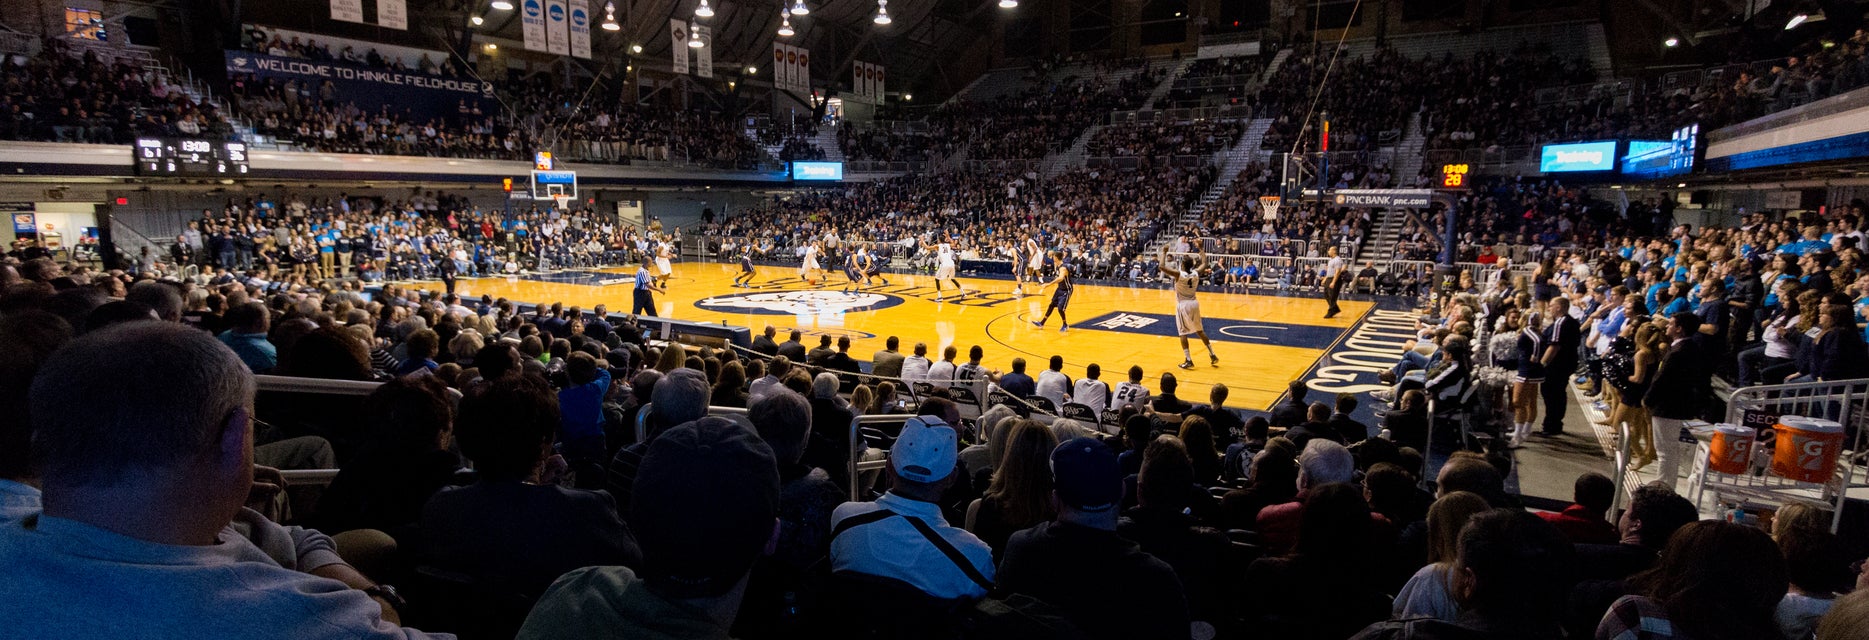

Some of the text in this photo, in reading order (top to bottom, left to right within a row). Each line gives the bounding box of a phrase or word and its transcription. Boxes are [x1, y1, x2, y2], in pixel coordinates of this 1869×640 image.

[255, 58, 331, 77] WELCOME
[334, 67, 354, 79] TO
[356, 70, 403, 85] HINKLE
[405, 75, 479, 93] FIELDHOUSE
[1443, 164, 1468, 174] 13:08
[1445, 174, 1462, 186] 28
[1117, 386, 1138, 402] 24
[1733, 440, 1746, 451] G
[1803, 441, 1824, 456] G
